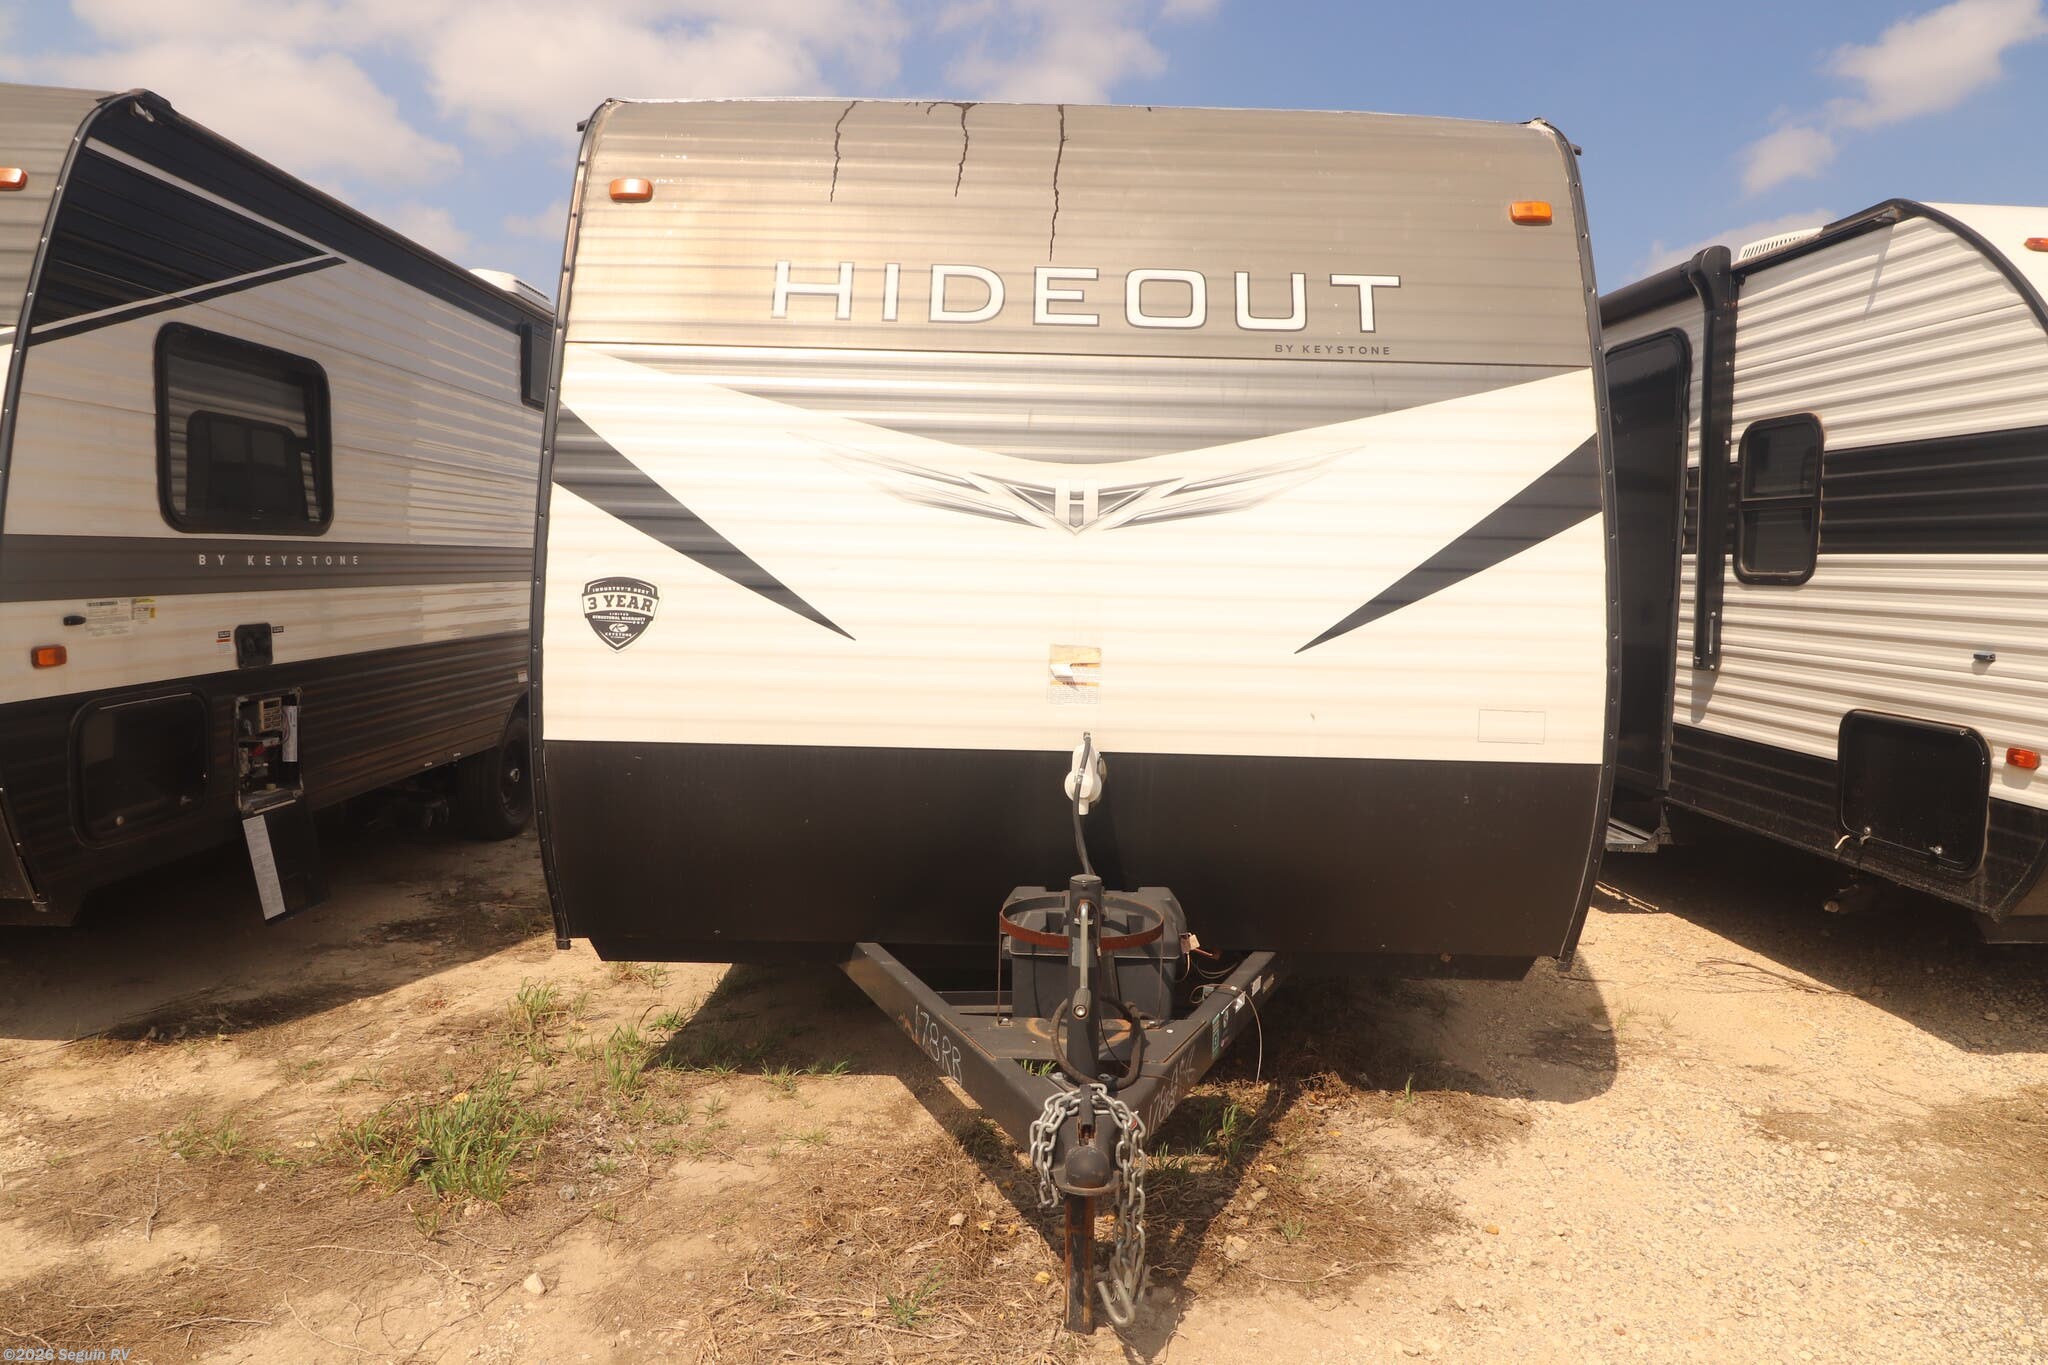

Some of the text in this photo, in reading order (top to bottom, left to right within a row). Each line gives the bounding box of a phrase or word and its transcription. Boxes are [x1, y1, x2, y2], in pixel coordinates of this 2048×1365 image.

[771, 260, 1401, 333] HIDEOUT
[1275, 344, 1390, 355] BY KEYSTONE
[198, 554, 359, 566] BY KEYSTONE
[587, 594, 653, 612] 3 YEAR
[914, 1003, 963, 1088] 178RB
